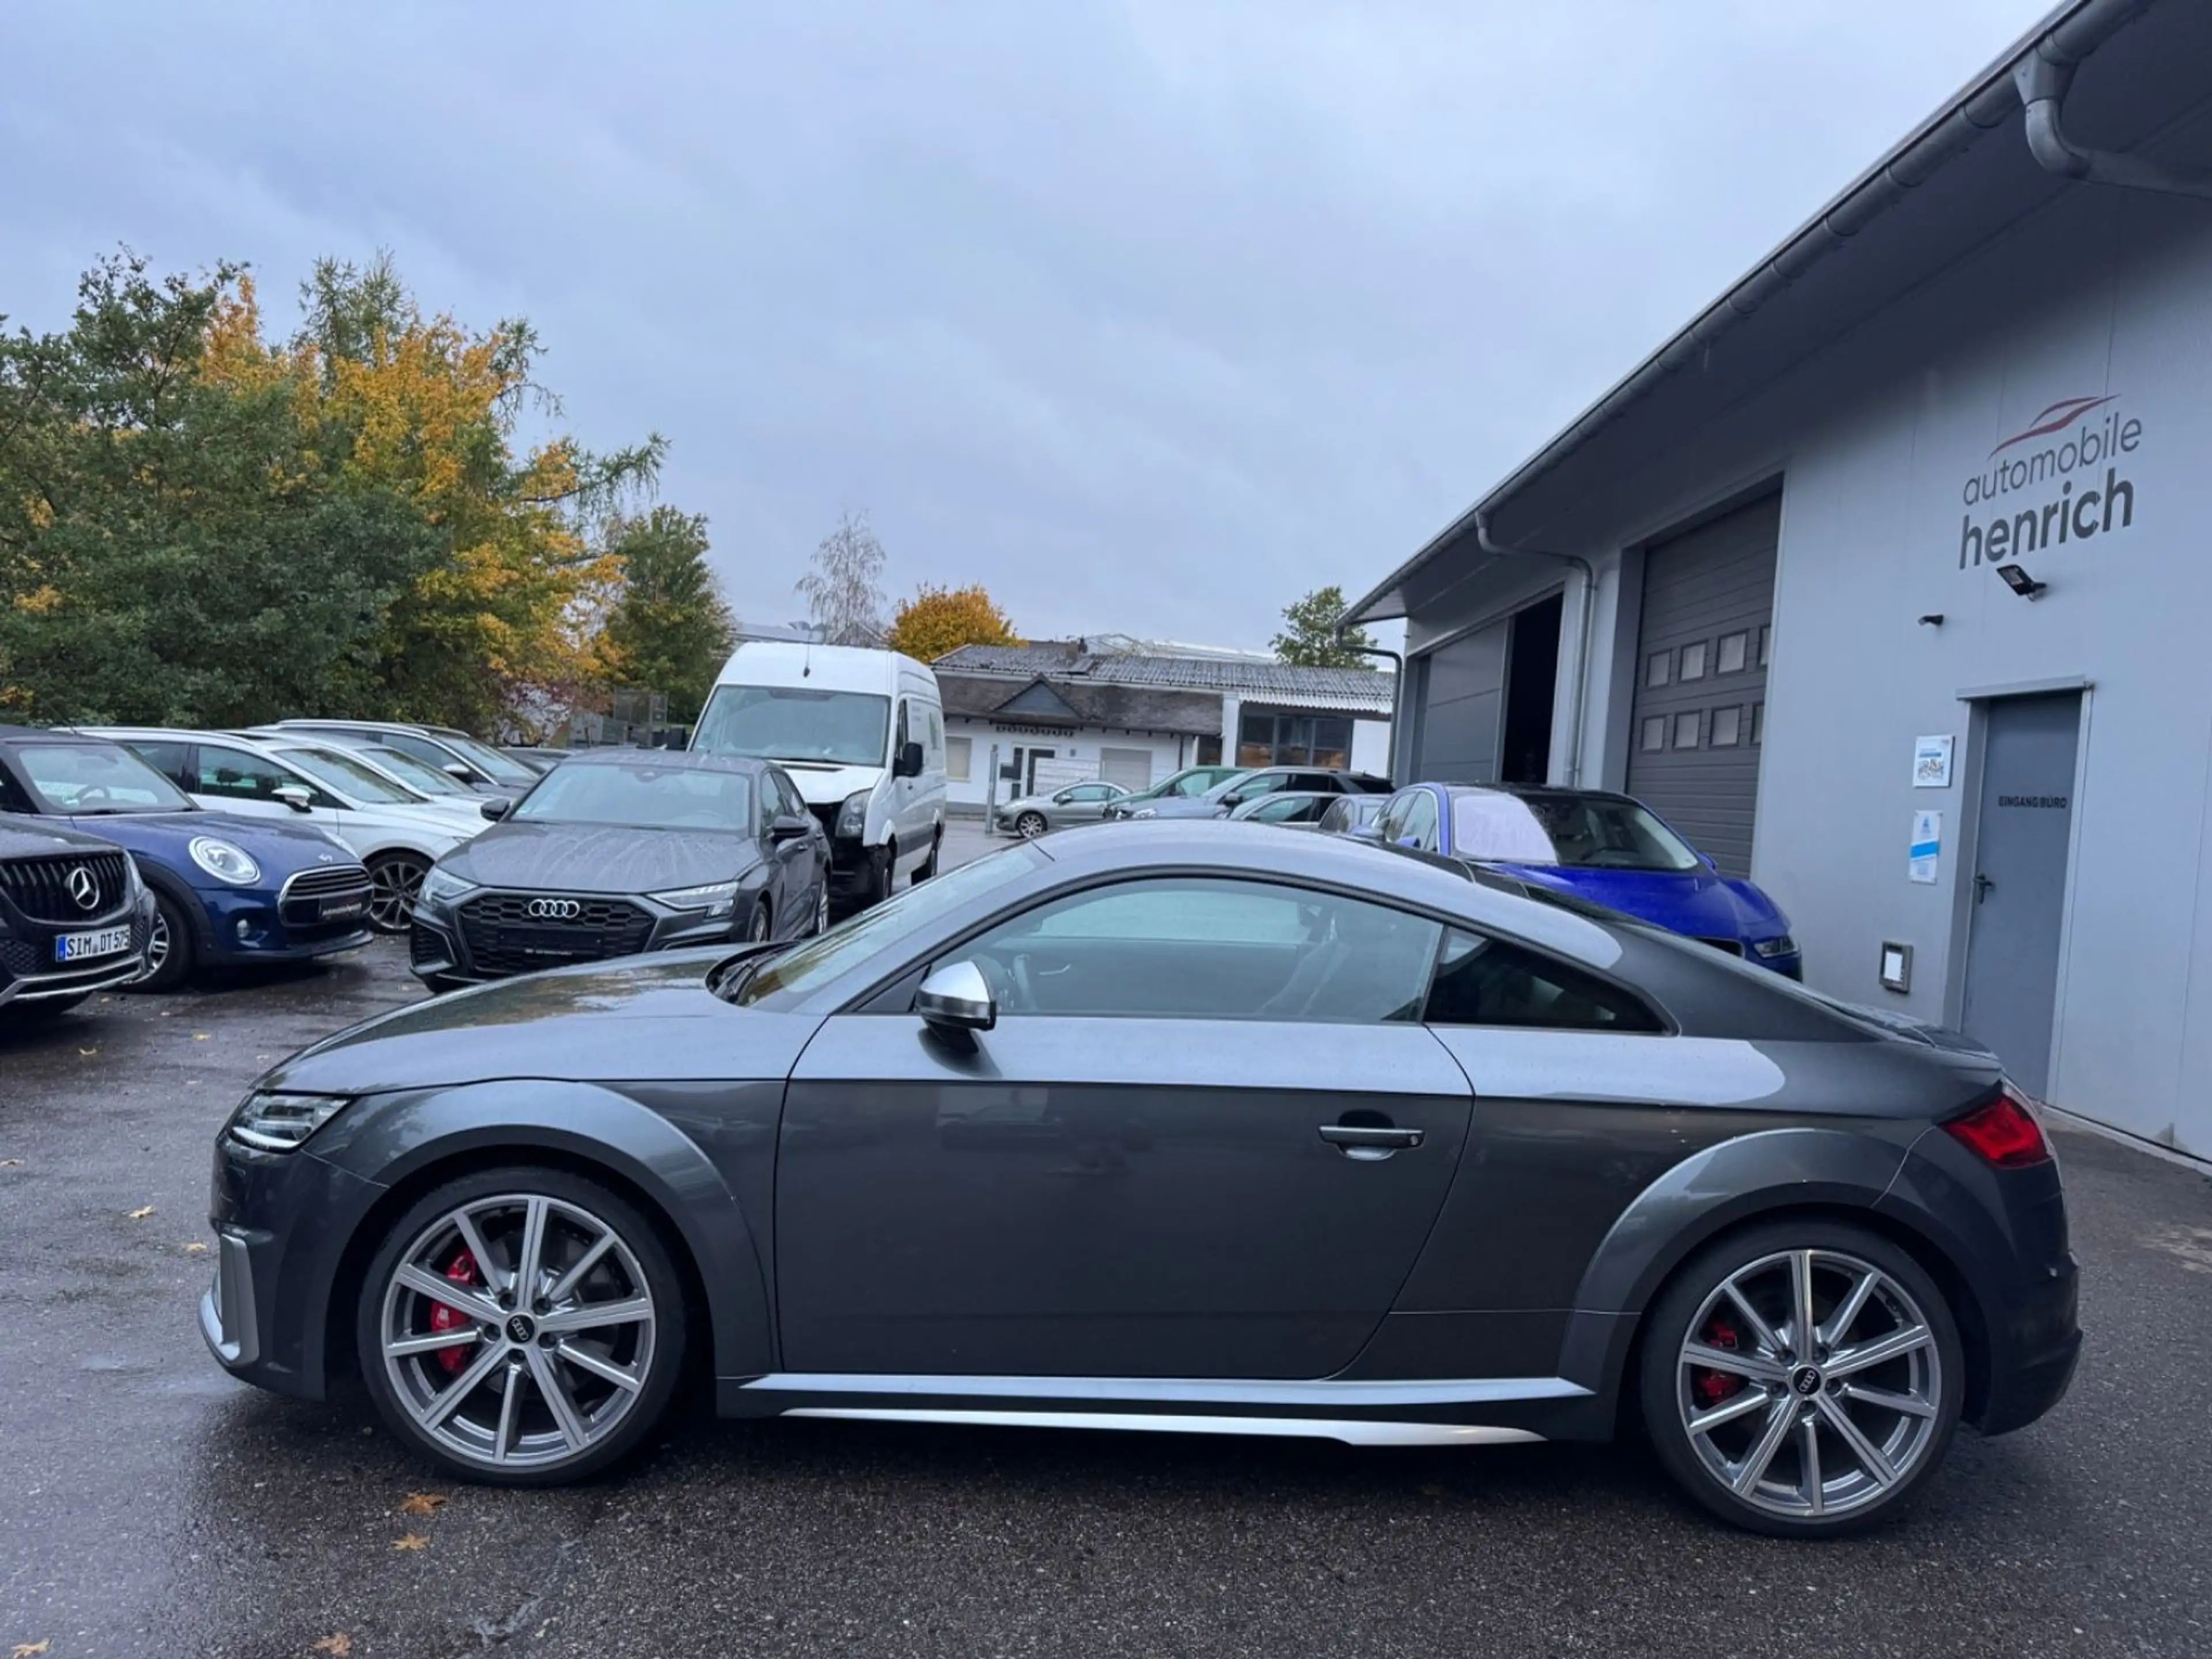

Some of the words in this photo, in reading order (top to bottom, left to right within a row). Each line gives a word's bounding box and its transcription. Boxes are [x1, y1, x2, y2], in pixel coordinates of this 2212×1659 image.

[1963, 411, 2142, 506] automobile
[1959, 467, 2134, 570] henrich
[66, 937, 91, 957] SIM
